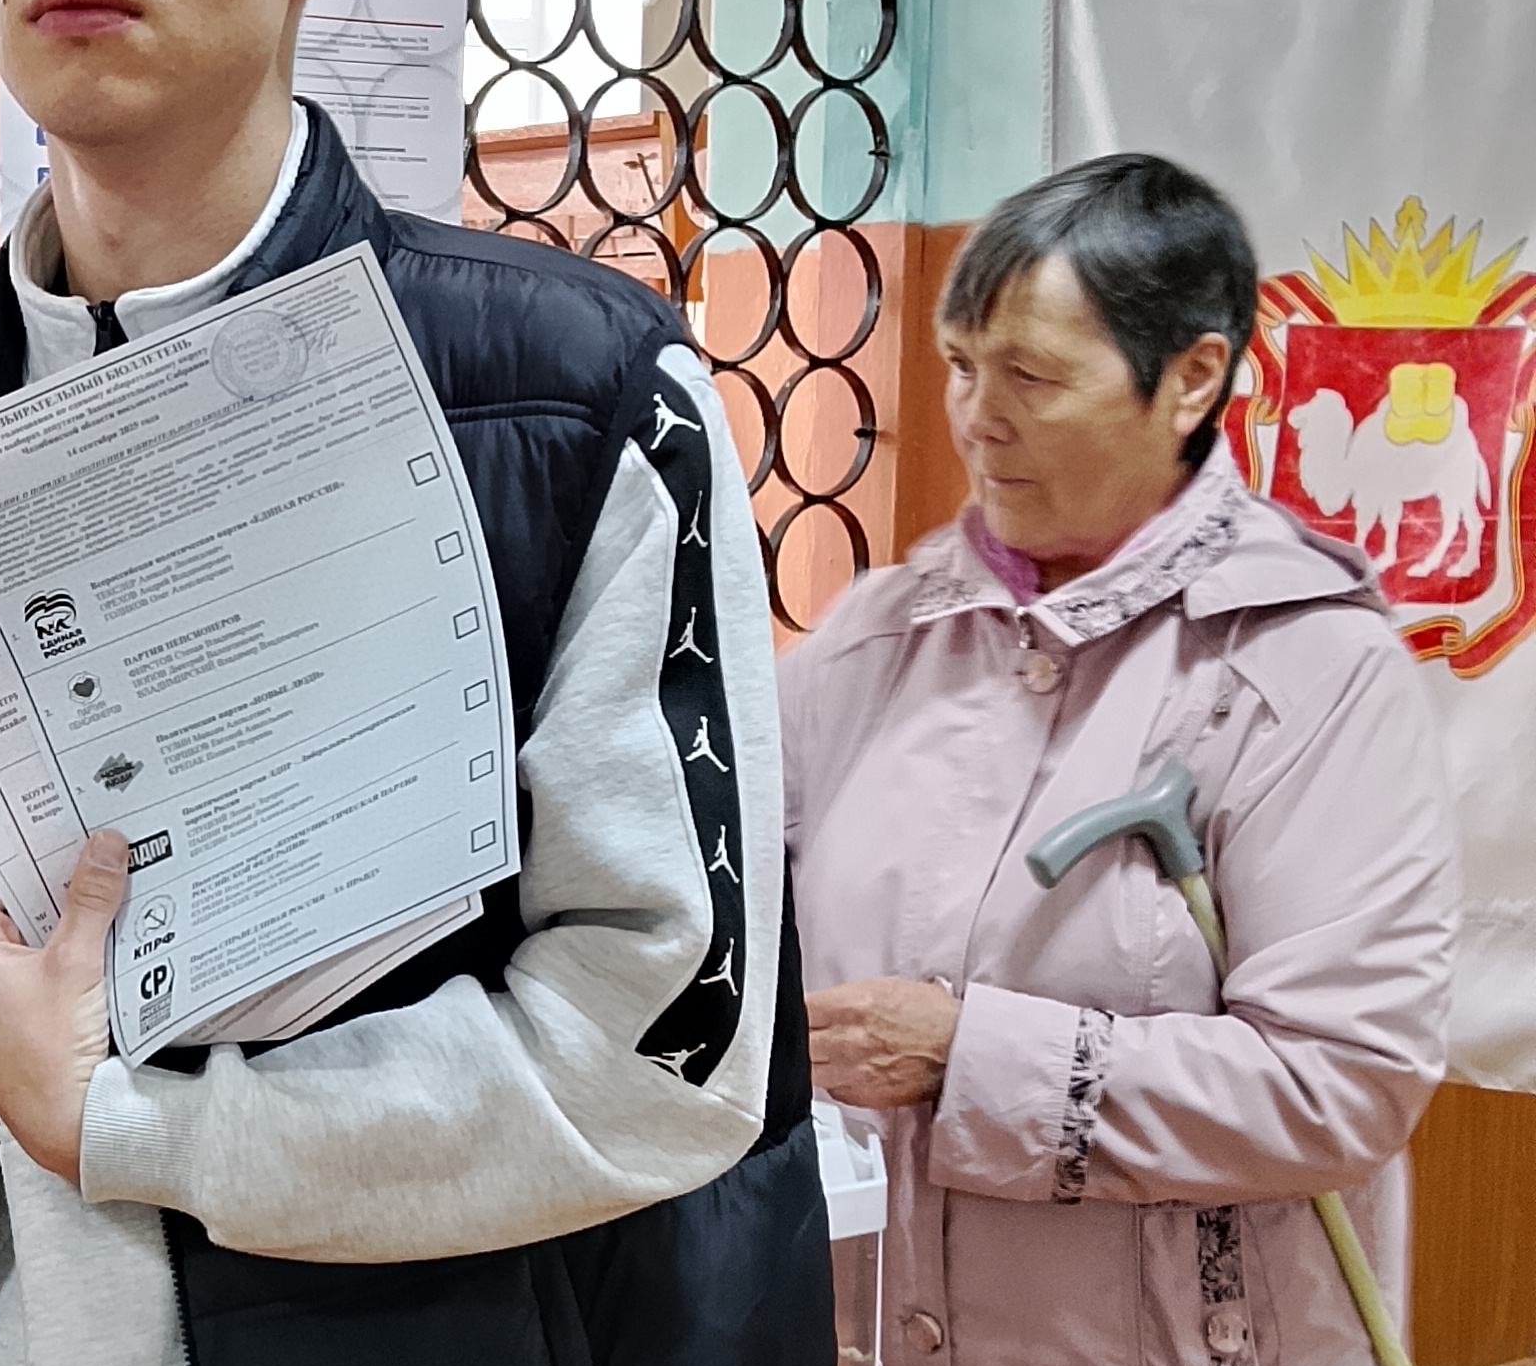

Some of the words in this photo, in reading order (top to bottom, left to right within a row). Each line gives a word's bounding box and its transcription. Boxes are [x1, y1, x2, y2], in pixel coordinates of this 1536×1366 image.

[105, 337, 192, 381] БЮЛЛЕТЕНЬ
[66, 447, 77, 457] 14
[77, 430, 118, 453] сентября
[118, 421, 139, 435] 2025
[40, 628, 82, 650] ЕДИНАЯ
[44, 637, 87, 659] РОССИЯ
[123, 644, 164, 666] ПАРТИЯ
[133, 932, 176, 960] КПРФ
[141, 965, 167, 1000] СР
